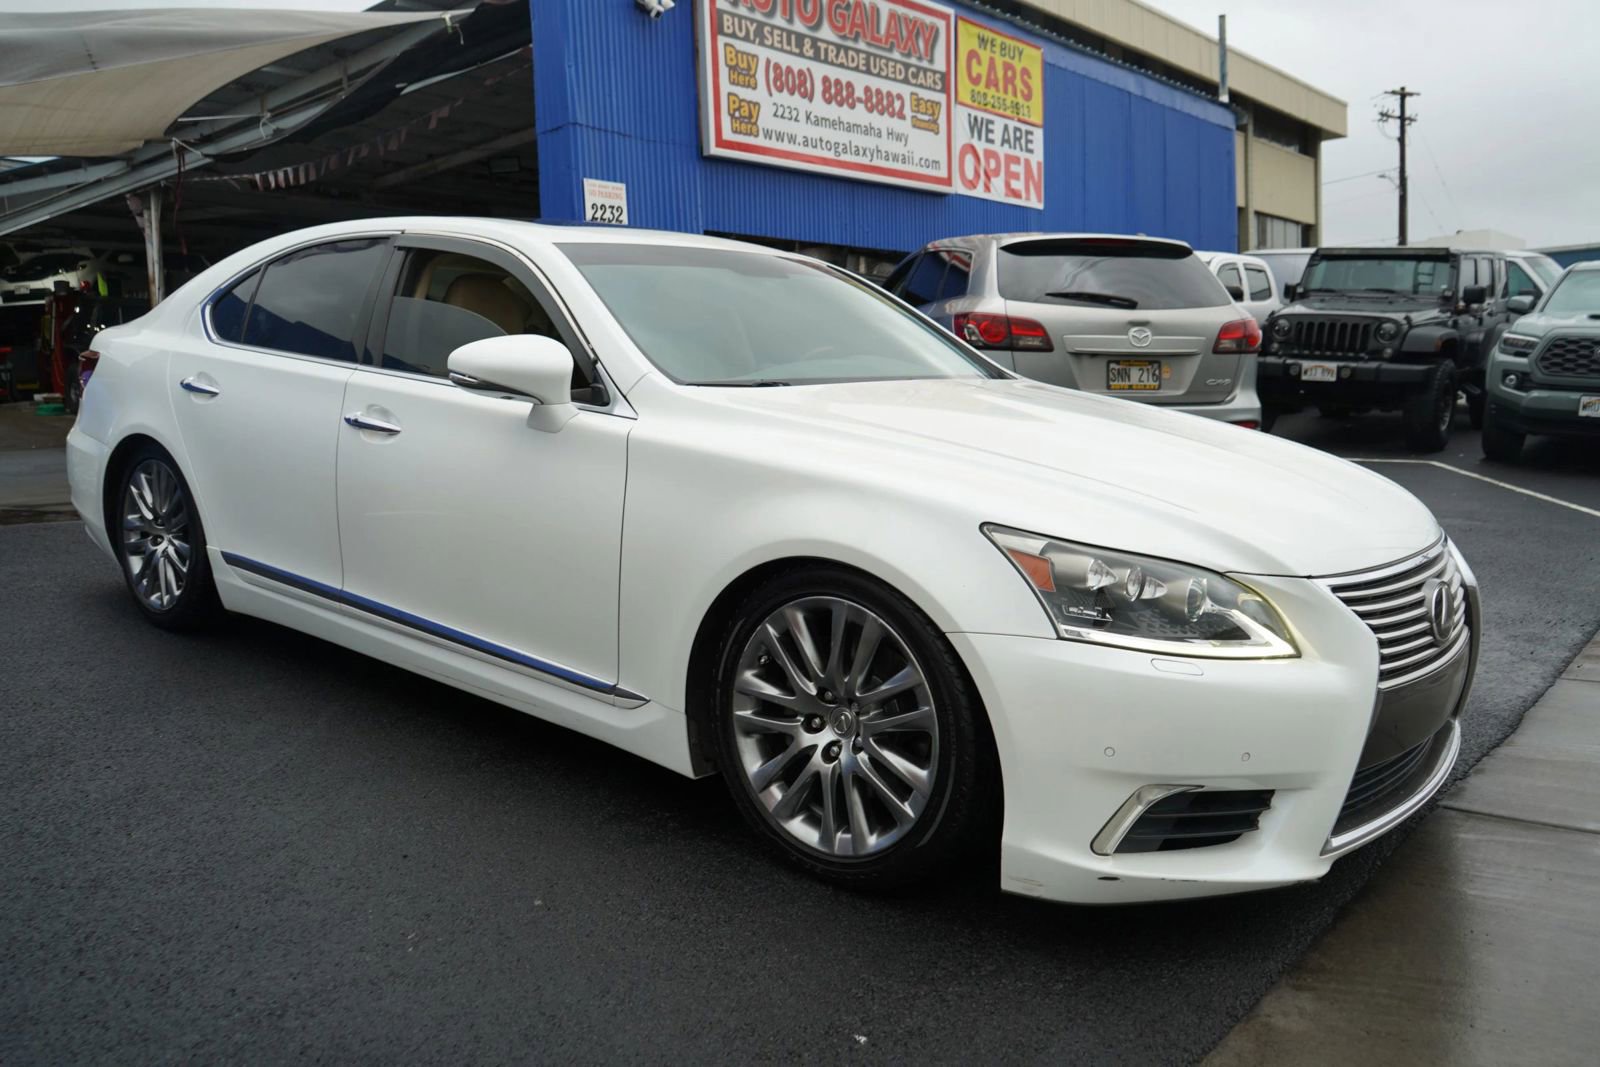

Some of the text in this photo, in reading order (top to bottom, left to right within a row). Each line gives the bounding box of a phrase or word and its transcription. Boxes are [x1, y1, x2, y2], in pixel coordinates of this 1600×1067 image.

[825, 0, 937, 60] GALAXY
[977, 32, 1024, 63] WE BUY
[723, 14, 942, 90] BUY, SELL & TRADE USED CARS
[724, 43, 759, 75] Buy
[729, 69, 757, 89] Here
[765, 57, 906, 121] (808) 888-8882
[966, 48, 1032, 102] CARS
[727, 92, 760, 122] Pay
[772, 102, 800, 122] 2232
[887, 127, 909, 147] Hwy
[910, 92, 941, 121] Easy
[731, 117, 759, 137] Here
[968, 112, 995, 145] WE
[1000, 123, 1034, 154] ARE
[763, 128, 941, 170] www.autogalaxyhawaii.com
[958, 143, 1042, 204] OPEN
[591, 203, 623, 224] 2232
[1110, 367, 1159, 383] SNN 216
